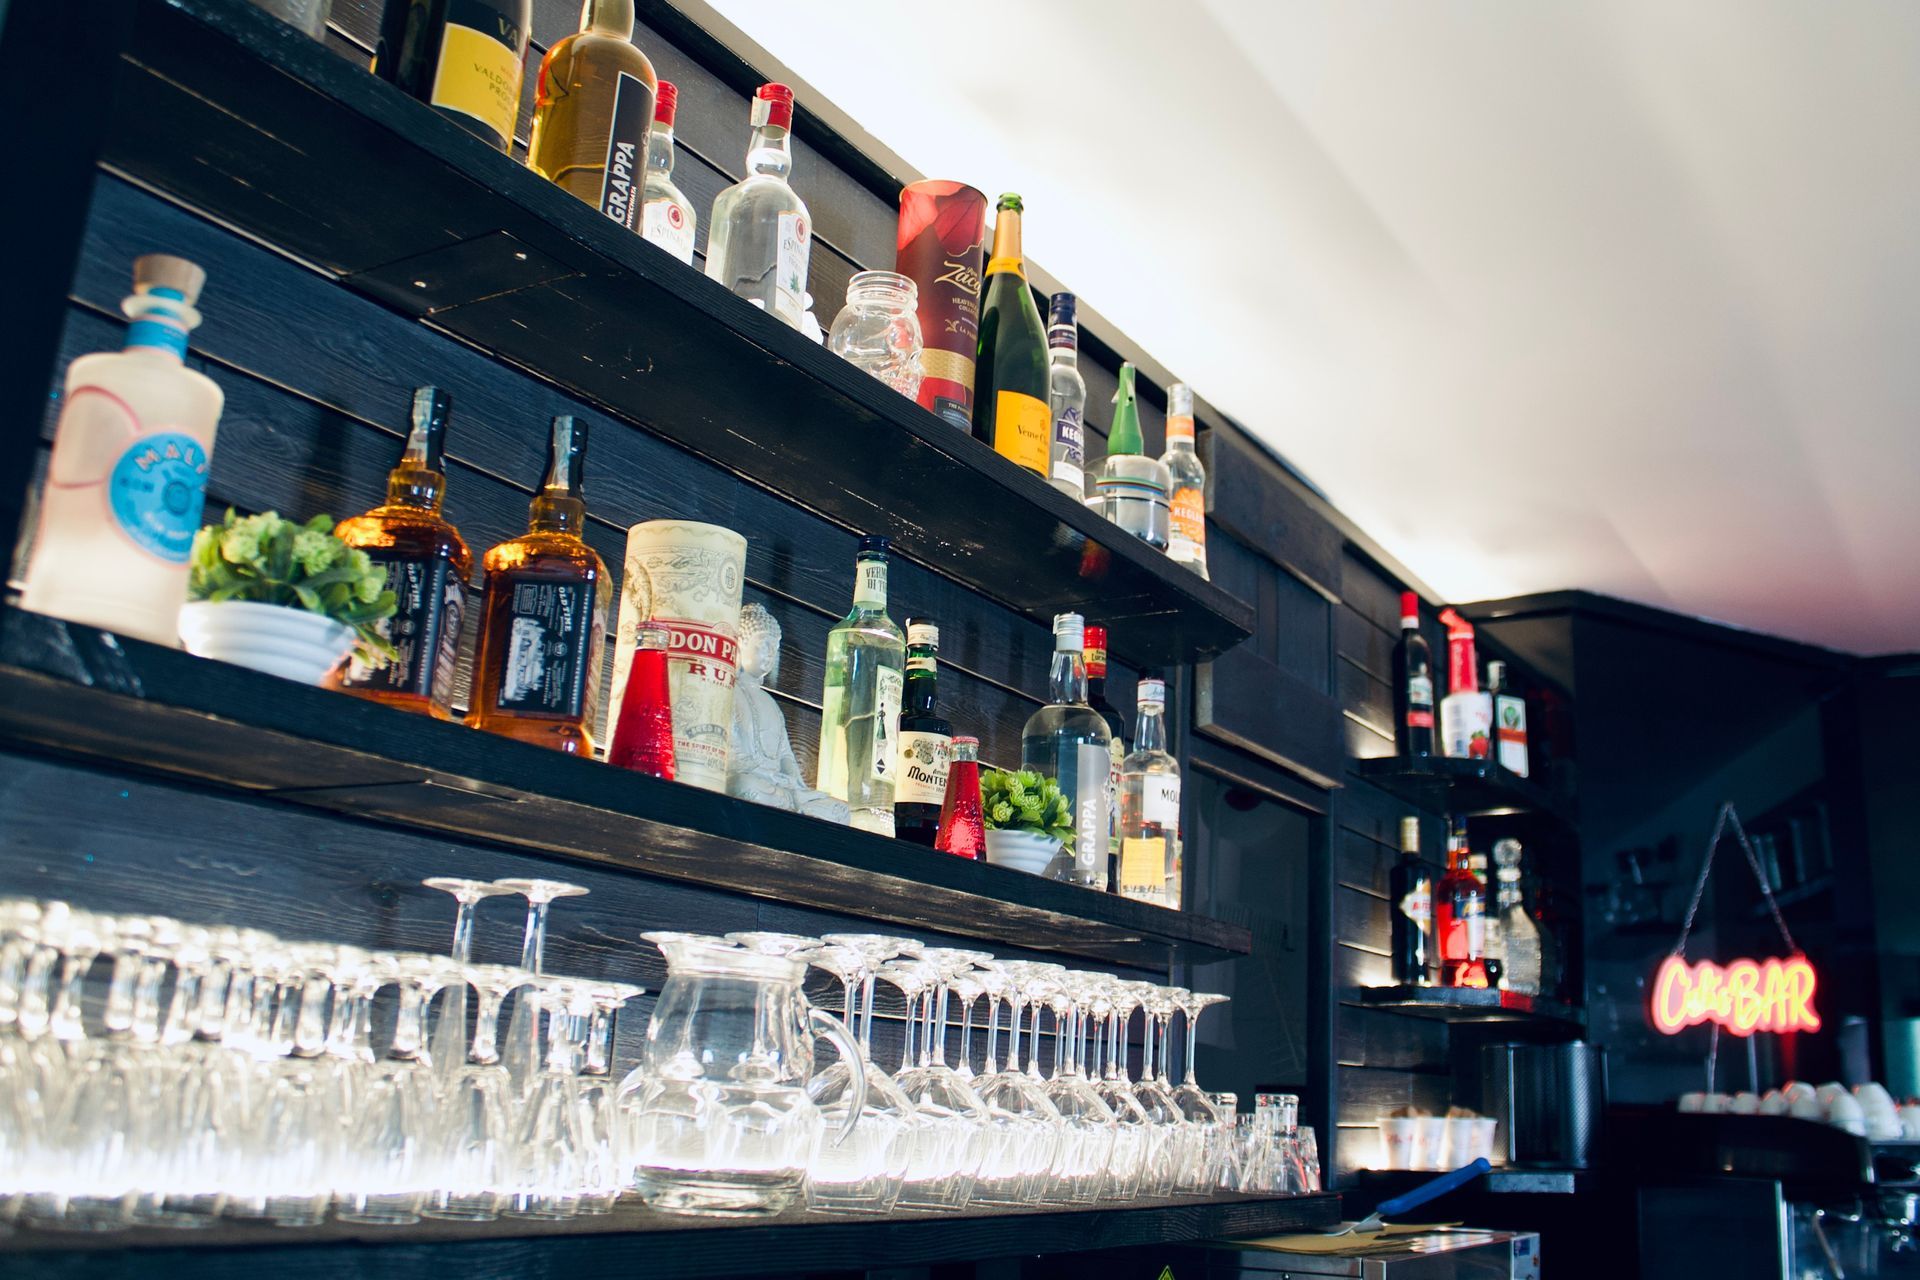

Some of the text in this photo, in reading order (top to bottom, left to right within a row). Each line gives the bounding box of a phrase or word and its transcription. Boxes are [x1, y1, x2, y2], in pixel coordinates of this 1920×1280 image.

[607, 142, 634, 224] GRAPPA
[562, 606, 573, 632] TIME
[669, 630, 718, 654] DON
[1081, 798, 1097, 866] GRAPPA
